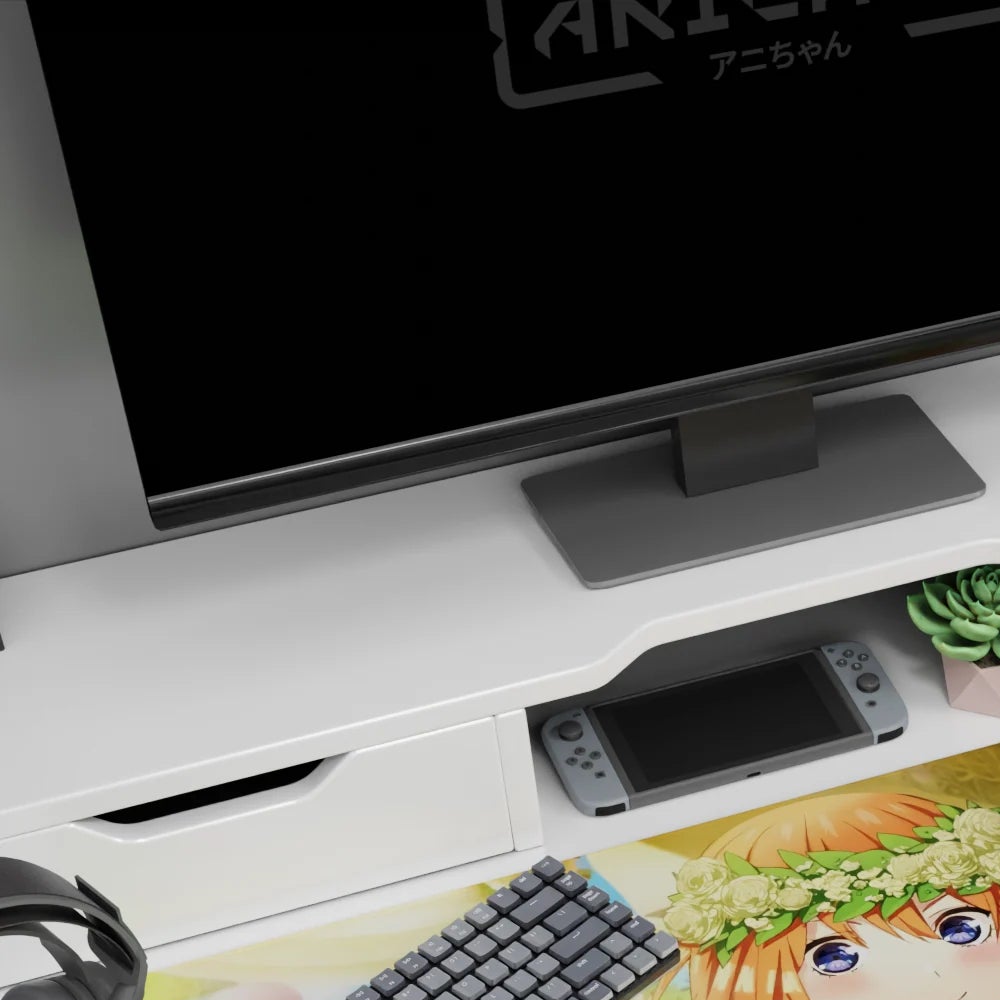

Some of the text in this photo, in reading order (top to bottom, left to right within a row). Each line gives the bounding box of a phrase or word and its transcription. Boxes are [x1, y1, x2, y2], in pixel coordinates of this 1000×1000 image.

[709, 30, 852, 80] アニちゃん
